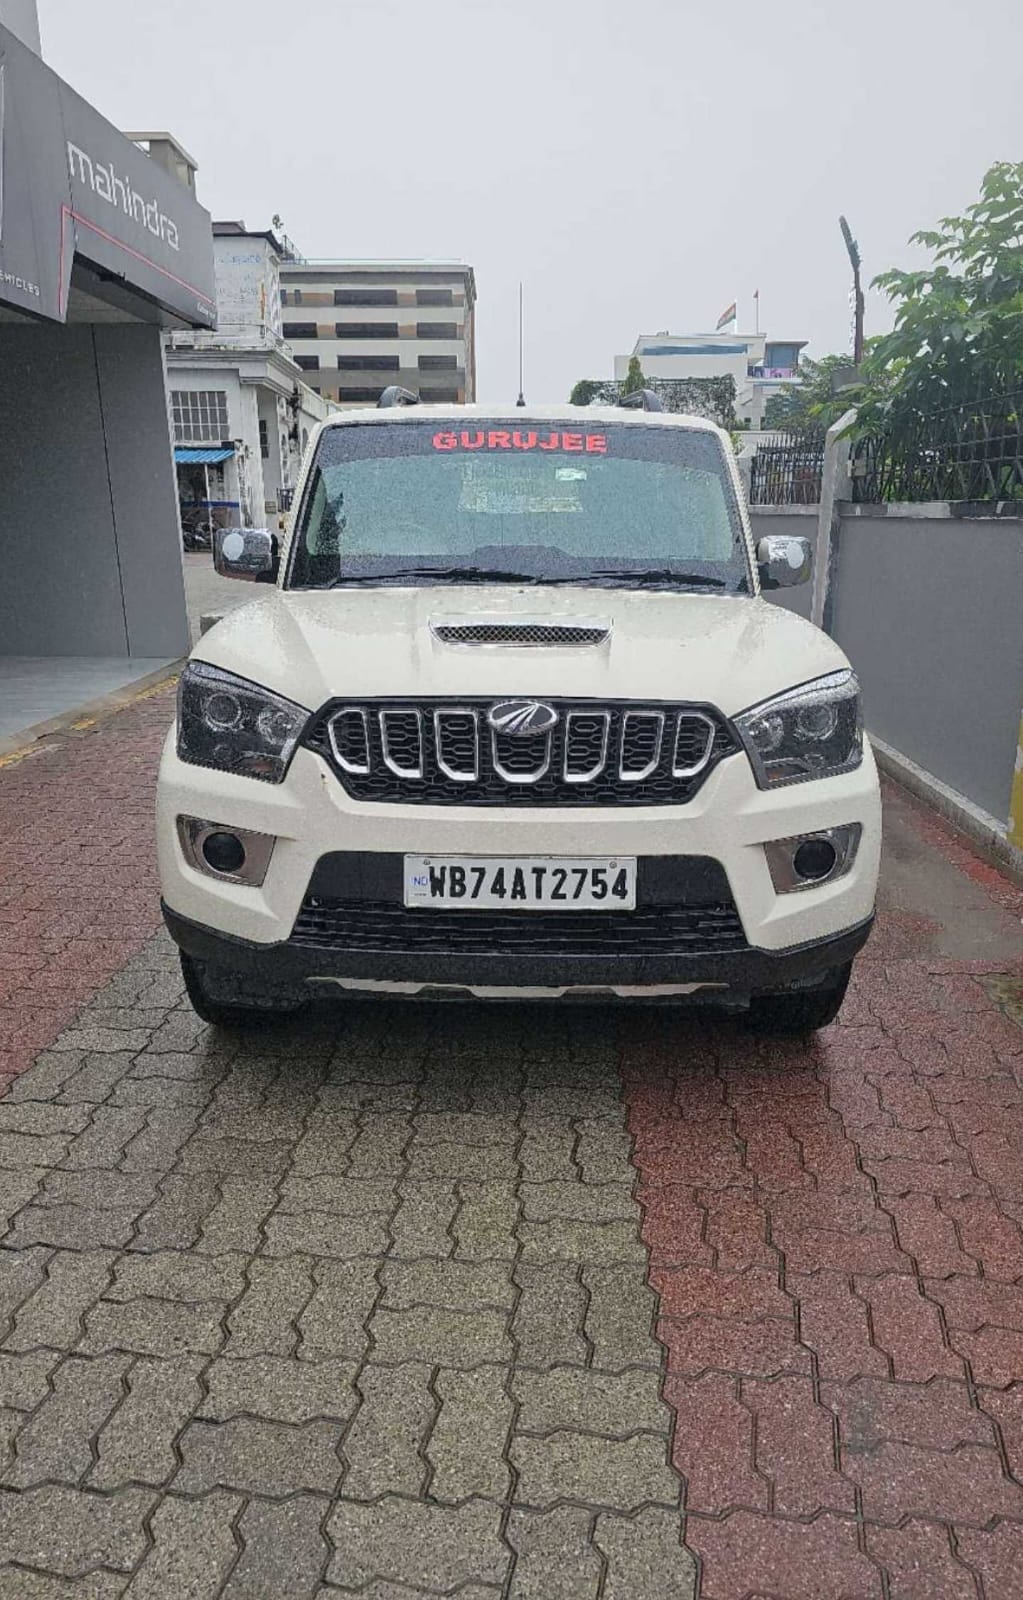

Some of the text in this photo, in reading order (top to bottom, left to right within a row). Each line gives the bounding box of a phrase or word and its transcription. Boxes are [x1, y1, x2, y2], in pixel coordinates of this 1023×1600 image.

[67, 141, 179, 250] mahindra
[432, 431, 607, 453] GURUJEE
[429, 865, 629, 899] WB74AT2754
